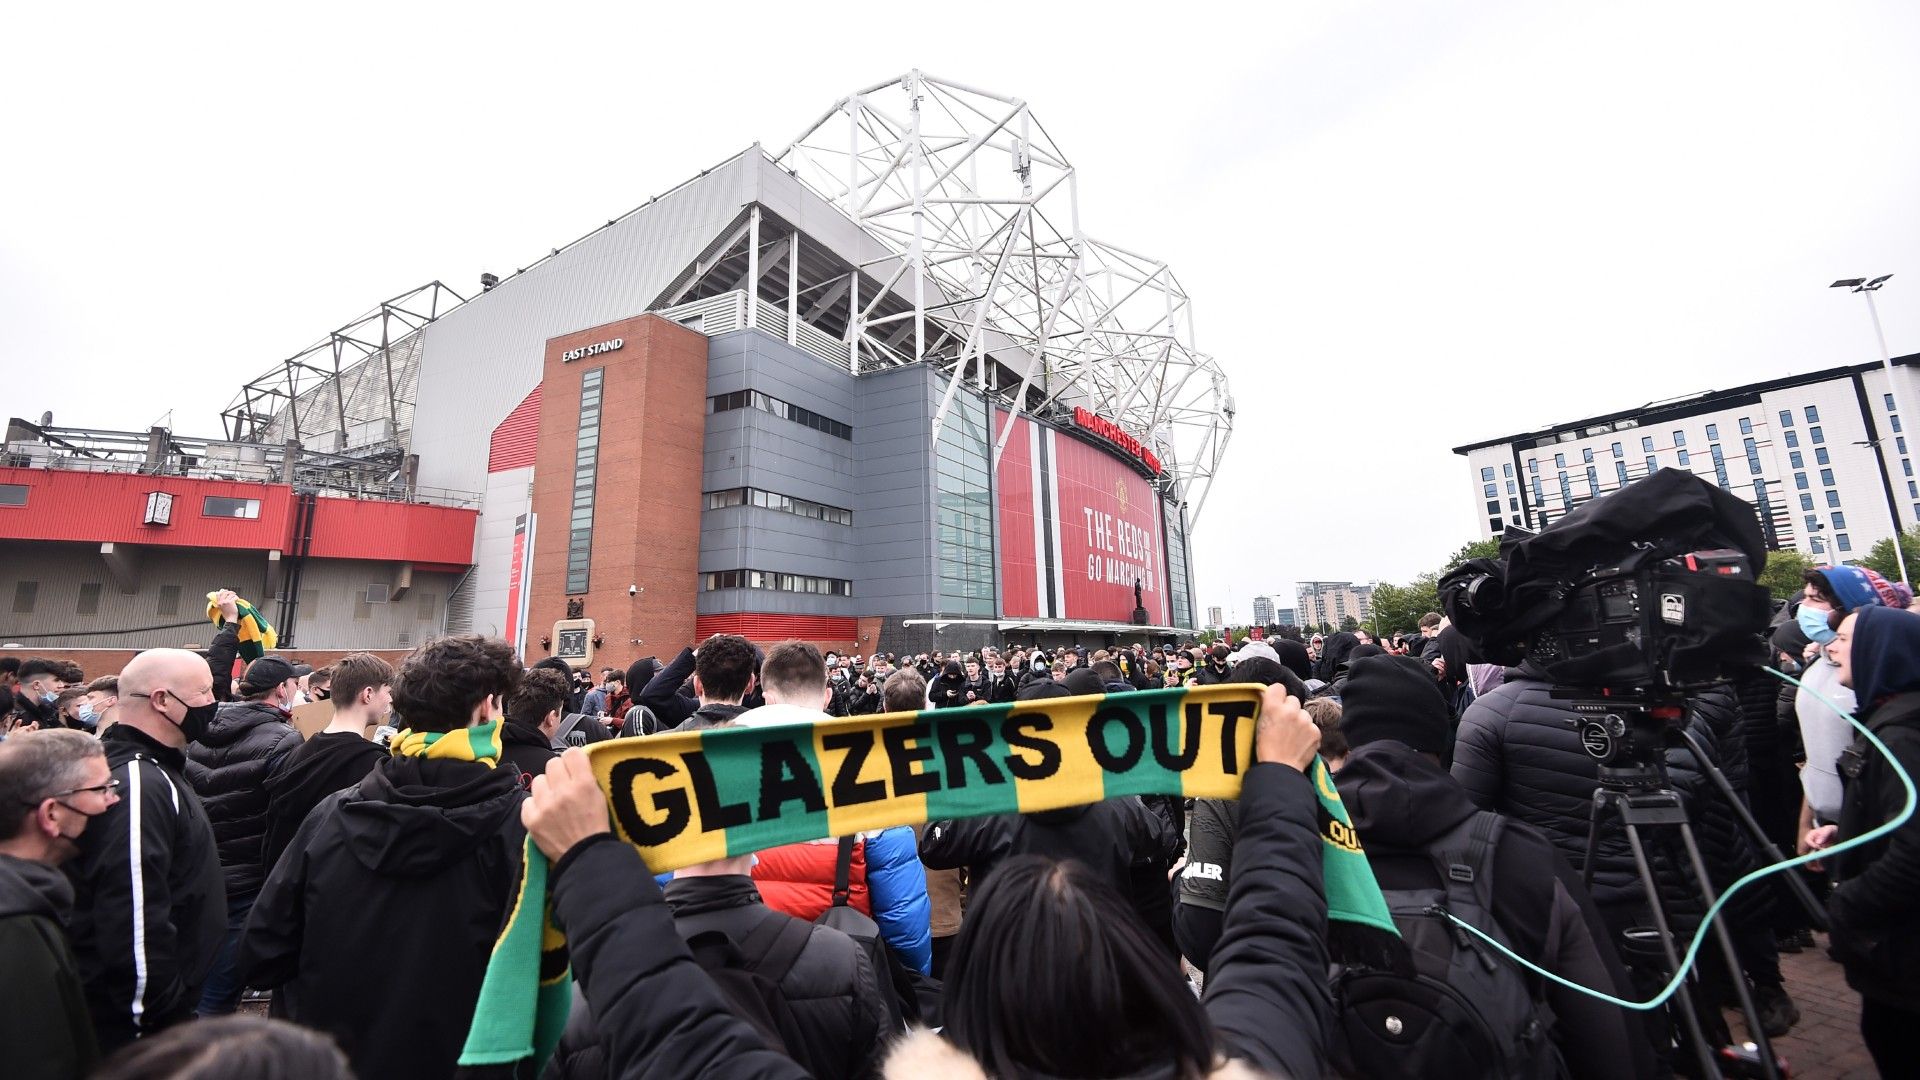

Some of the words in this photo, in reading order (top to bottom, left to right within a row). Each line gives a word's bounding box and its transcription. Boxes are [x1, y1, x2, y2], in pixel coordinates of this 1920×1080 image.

[562, 347, 586, 362] EAST
[587, 338, 623, 356] STAND
[1074, 406, 1141, 457] MANCHESTER
[1083, 506, 1114, 552] THE
[1117, 518, 1144, 562] REDS
[1087, 553, 1102, 581] GO
[1106, 557, 1146, 591] MARCHING
[610, 713, 1062, 847] GLAZERS
[1085, 701, 1257, 775] OUT
[1329, 820, 1361, 850] OU
